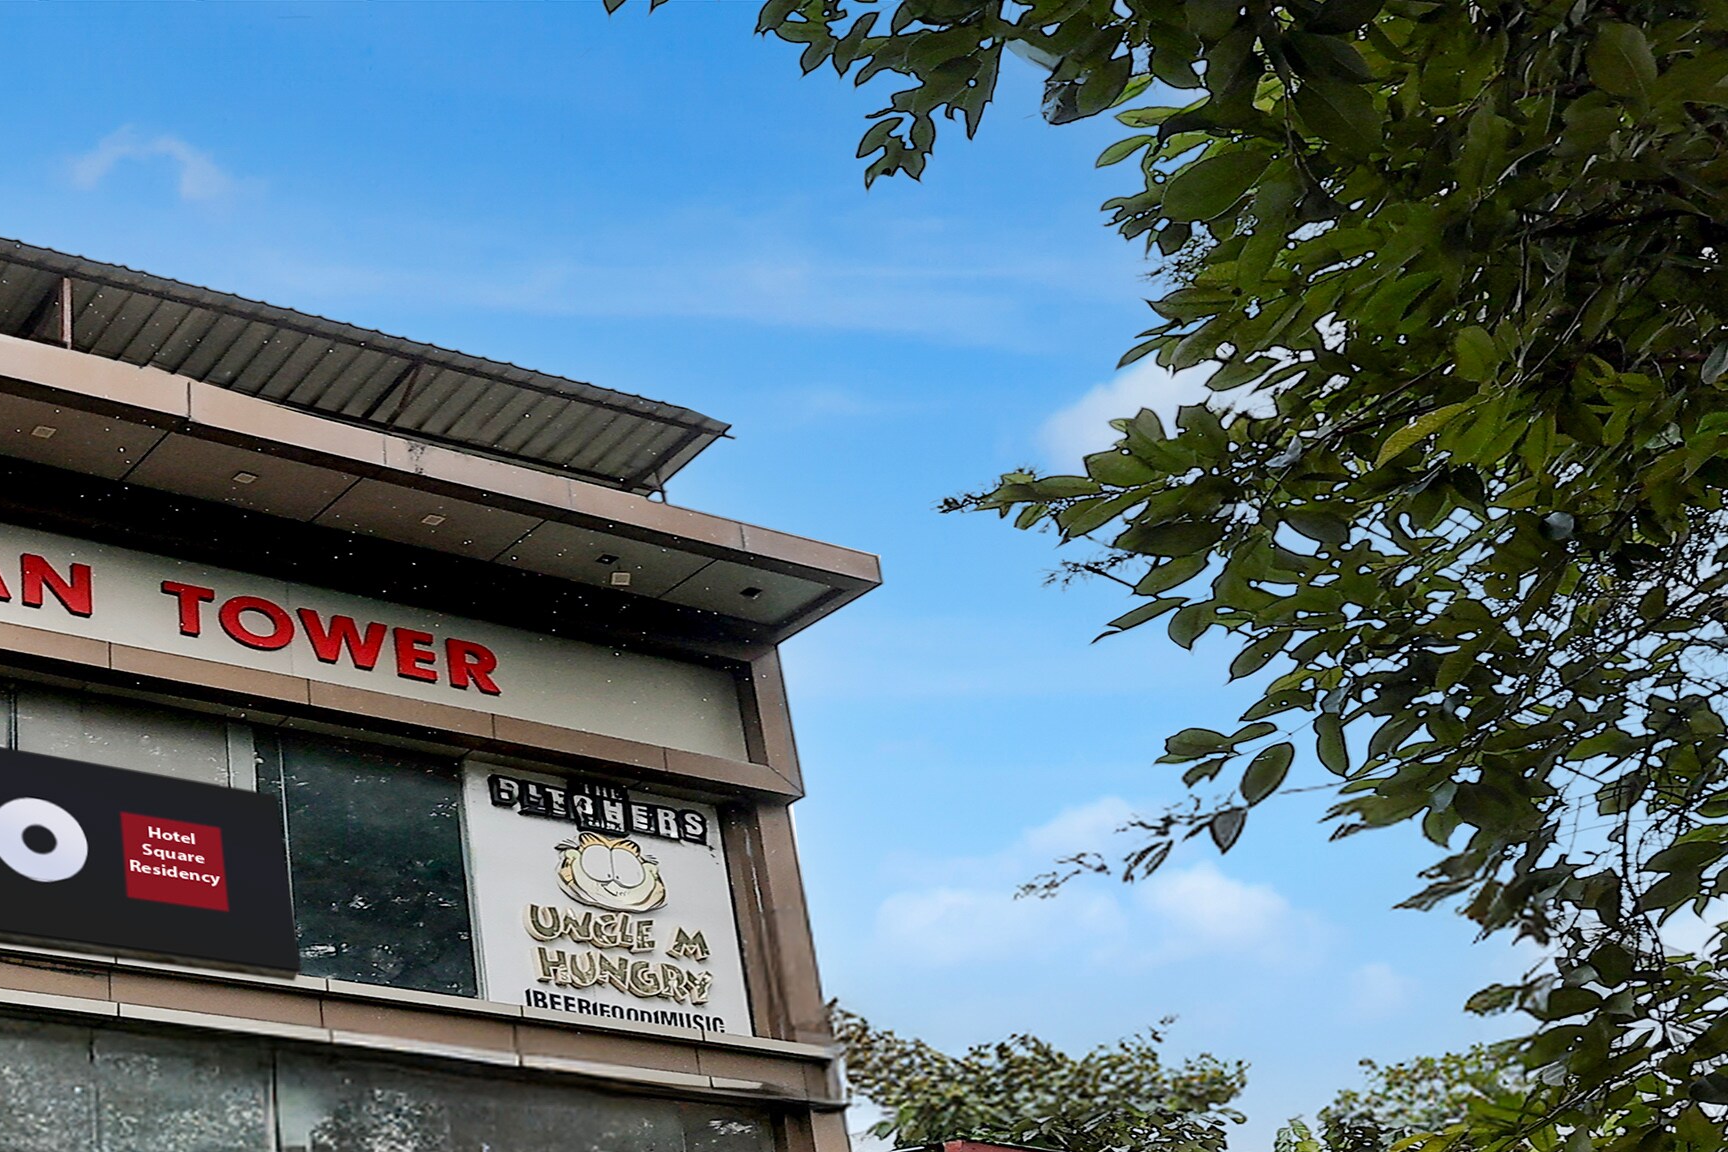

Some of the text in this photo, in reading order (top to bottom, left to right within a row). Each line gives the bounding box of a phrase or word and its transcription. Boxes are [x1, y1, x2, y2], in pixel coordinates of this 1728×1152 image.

[161, 580, 501, 697] TOWER
[142, 843, 206, 868] Square
[147, 825, 196, 845] Hotel
[129, 860, 221, 887] Residency
[525, 904, 711, 962] UNCLE M
[532, 946, 714, 1006] HUNGRY
